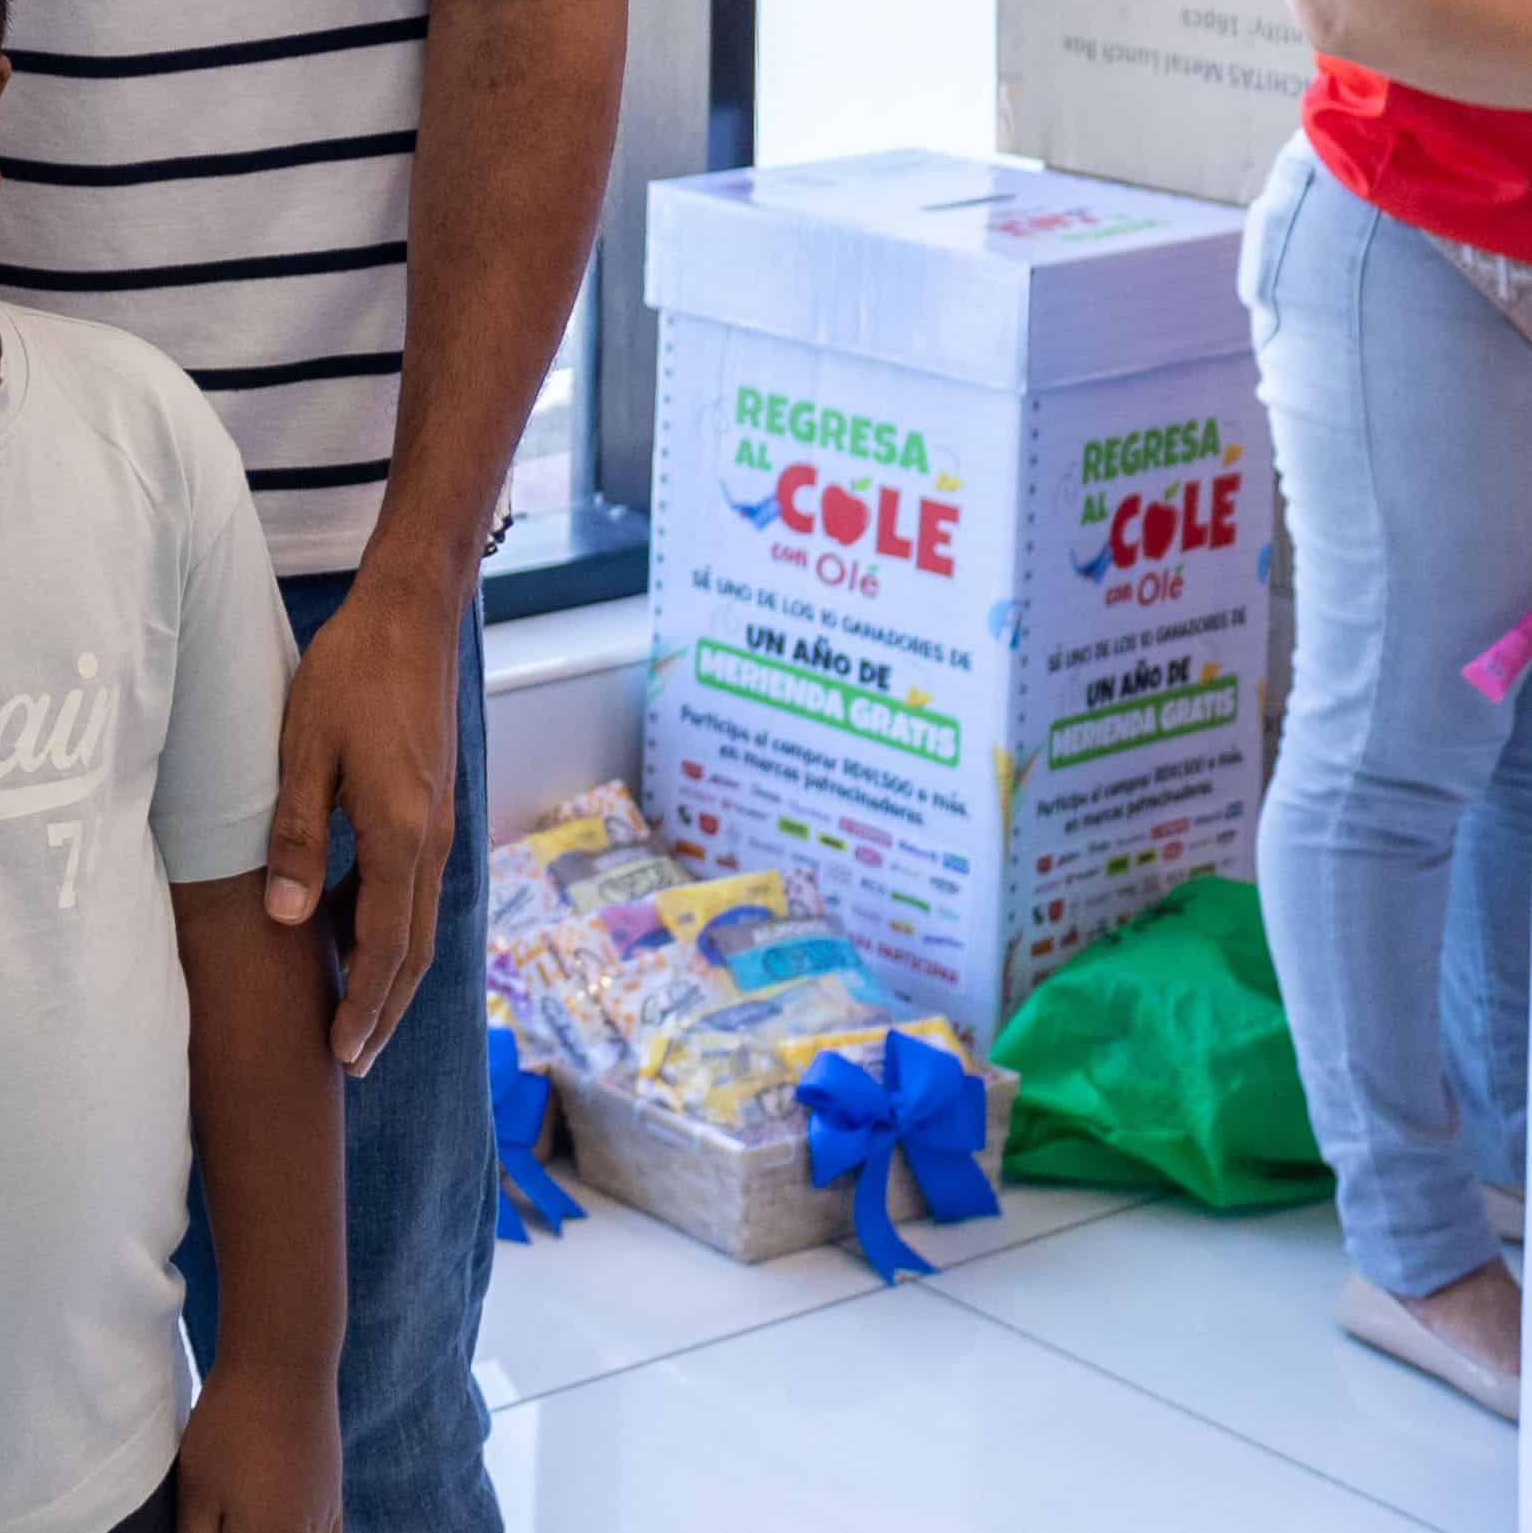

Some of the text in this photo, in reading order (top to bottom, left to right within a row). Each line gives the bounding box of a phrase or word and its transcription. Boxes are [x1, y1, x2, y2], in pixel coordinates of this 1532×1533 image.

[734, 437, 772, 472] AL
[735, 385, 929, 474] REGRESA
[1081, 416, 1220, 485] REGRESA
[1081, 490, 1108, 527] AL
[771, 542, 880, 598] con Olé
[1105, 565, 1184, 608] con Olé
[717, 577, 752, 602] UNO
[757, 588, 776, 610] DE
[783, 596, 814, 621] LOS
[843, 616, 944, 662] GANADORES
[950, 648, 972, 671] DE
[746, 622, 892, 692] UN AÑO DE
[699, 644, 958, 762] MERIENDA GRATIS
[1087, 655, 1191, 707] UN AÑO DE
[682, 703, 750, 744] Participa
[772, 737, 838, 770] comprar
[743, 751, 800, 781] marcas
[46, 819, 83, 909] 7
